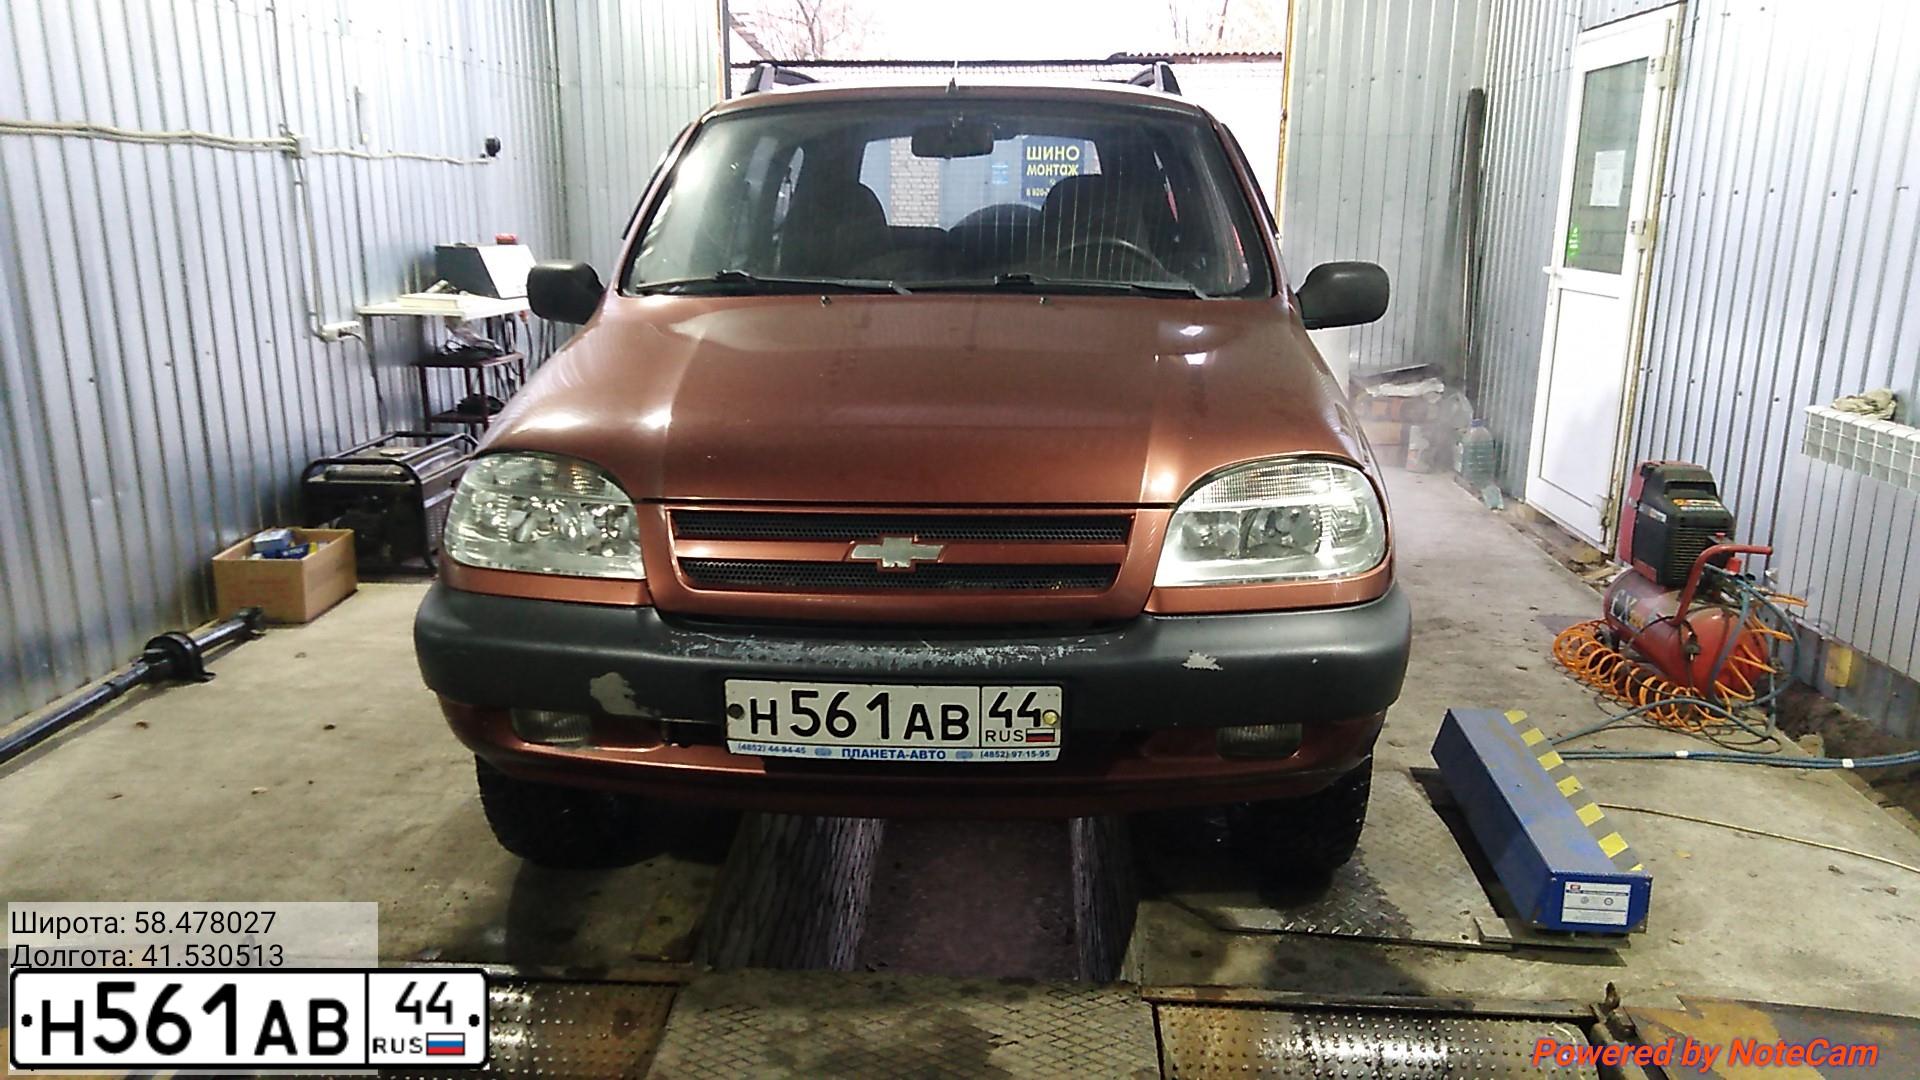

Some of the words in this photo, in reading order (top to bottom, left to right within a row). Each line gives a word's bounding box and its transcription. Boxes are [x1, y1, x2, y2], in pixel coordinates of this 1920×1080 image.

[1026, 145, 1080, 161] ШИНО
[988, 691, 1042, 729] 44
[985, 729, 1025, 743] RUS
[841, 748, 947, 760] ПЛАНЕТА-АВТО
